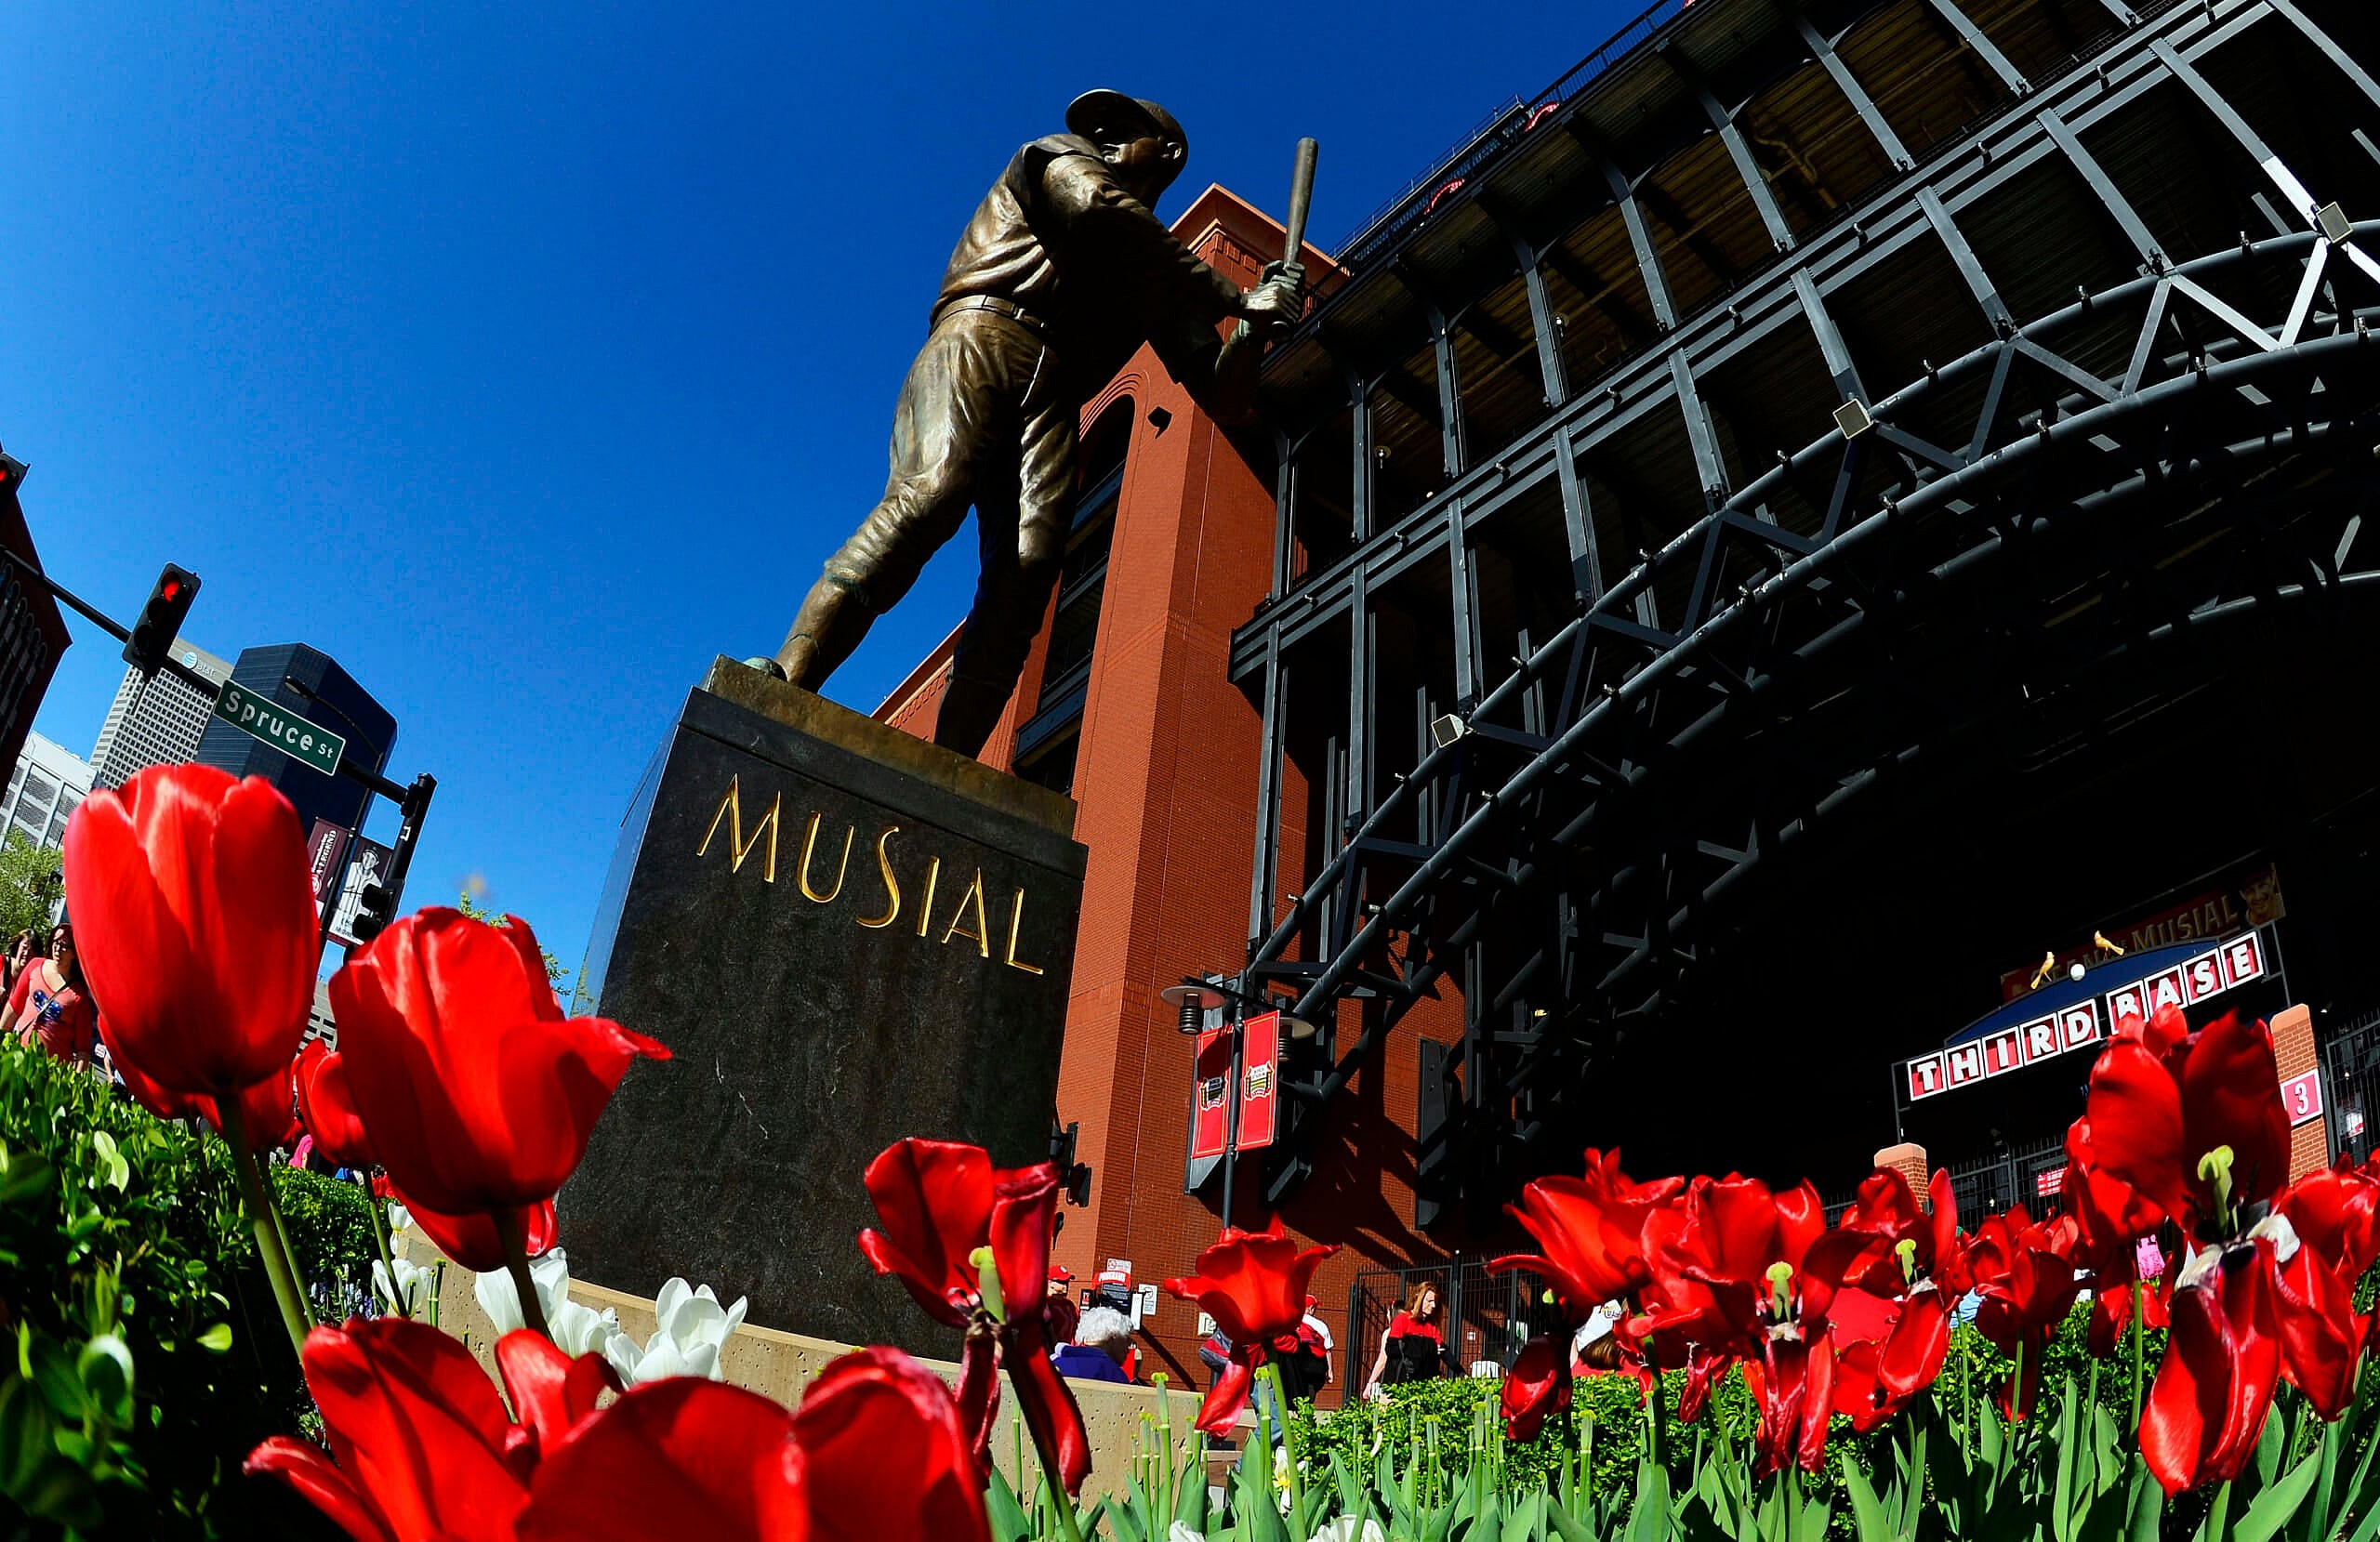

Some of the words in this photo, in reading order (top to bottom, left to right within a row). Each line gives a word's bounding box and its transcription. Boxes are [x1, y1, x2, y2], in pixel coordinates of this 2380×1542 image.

[224, 691, 313, 751] Spruce
[317, 743, 334, 758] St
[319, 829, 337, 868] LEGEND
[695, 772, 1044, 975] MUSIAL
[2130, 894, 2239, 953] MUSIAL
[1916, 1010, 2093, 1092] THIRD
[2114, 942, 2253, 1018] BASE
[2294, 1082, 2309, 1115] 3
